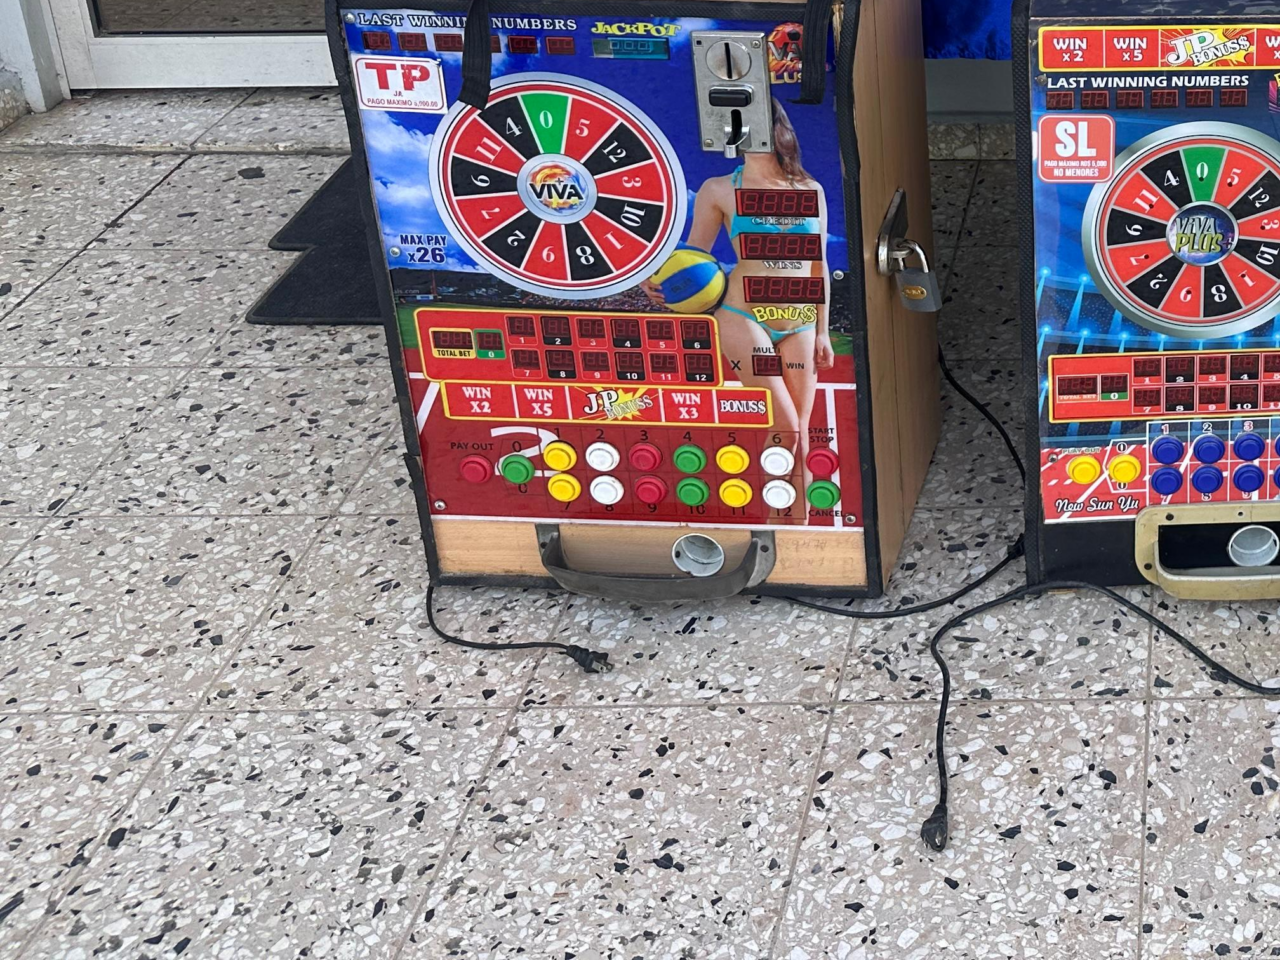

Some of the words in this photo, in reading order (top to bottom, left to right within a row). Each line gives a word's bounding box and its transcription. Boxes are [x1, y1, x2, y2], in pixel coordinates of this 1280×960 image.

[358, 13, 404, 27] LAST
[491, 17, 577, 30] NUMBERS
[1053, 37, 1087, 51] WIN
[1113, 37, 1147, 50] WIN
[1166, 31, 1214, 66] JP
[364, 62, 430, 91] TP
[1047, 76, 1088, 89] LAST
[1091, 76, 1168, 88] WINNING
[1171, 75, 1249, 88] NUMBERS
[540, 110, 553, 128] 0
[505, 117, 523, 137] 4
[575, 119, 591, 137] 5
[1055, 121, 1097, 157] SL
[602, 140, 627, 163] 12
[1053, 168, 1064, 177] NO
[1065, 168, 1099, 177] MENORES
[1196, 162, 1209, 179] 0
[1164, 170, 1180, 187] 4
[1227, 168, 1242, 186] 5
[529, 183, 584, 200] VIVA
[1248, 187, 1270, 207] 12
[751, 217, 806, 226] CREDIT
[400, 234, 423, 246] MAX
[426, 235, 447, 246] PAY
[1175, 232, 1223, 253] PLUS
[575, 245, 595, 265] 8
[762, 261, 803, 269] WINS
[1211, 285, 1228, 302] 8
[437, 349, 457, 357] TOTAL
[786, 361, 805, 370] WIN
[462, 387, 491, 399] WIN
[524, 388, 553, 400] WIN
[671, 393, 700, 405] WIN
[470, 401, 491, 413] X2
[583, 389, 618, 414] JP
[531, 403, 553, 416] X5
[679, 407, 699, 419] X3
[1161, 424, 1169, 434] 1
[1202, 422, 1213, 433] 2
[1243, 421, 1253, 431] 3
[554, 428, 561, 439] 1
[596, 429, 605, 440] 2
[640, 430, 649, 441] 3
[683, 431, 692, 442] 4
[728, 432, 736, 443] 5
[772, 433, 781, 444] 6
[450, 442, 469, 450] PAY
[512, 441, 522, 452] 0
[1117, 442, 1127, 452] 0
[1055, 498, 1084, 512] New
[1087, 497, 1113, 511] Sun
[1117, 496, 1140, 512] Yu
[808, 510, 845, 518] CANCEL
